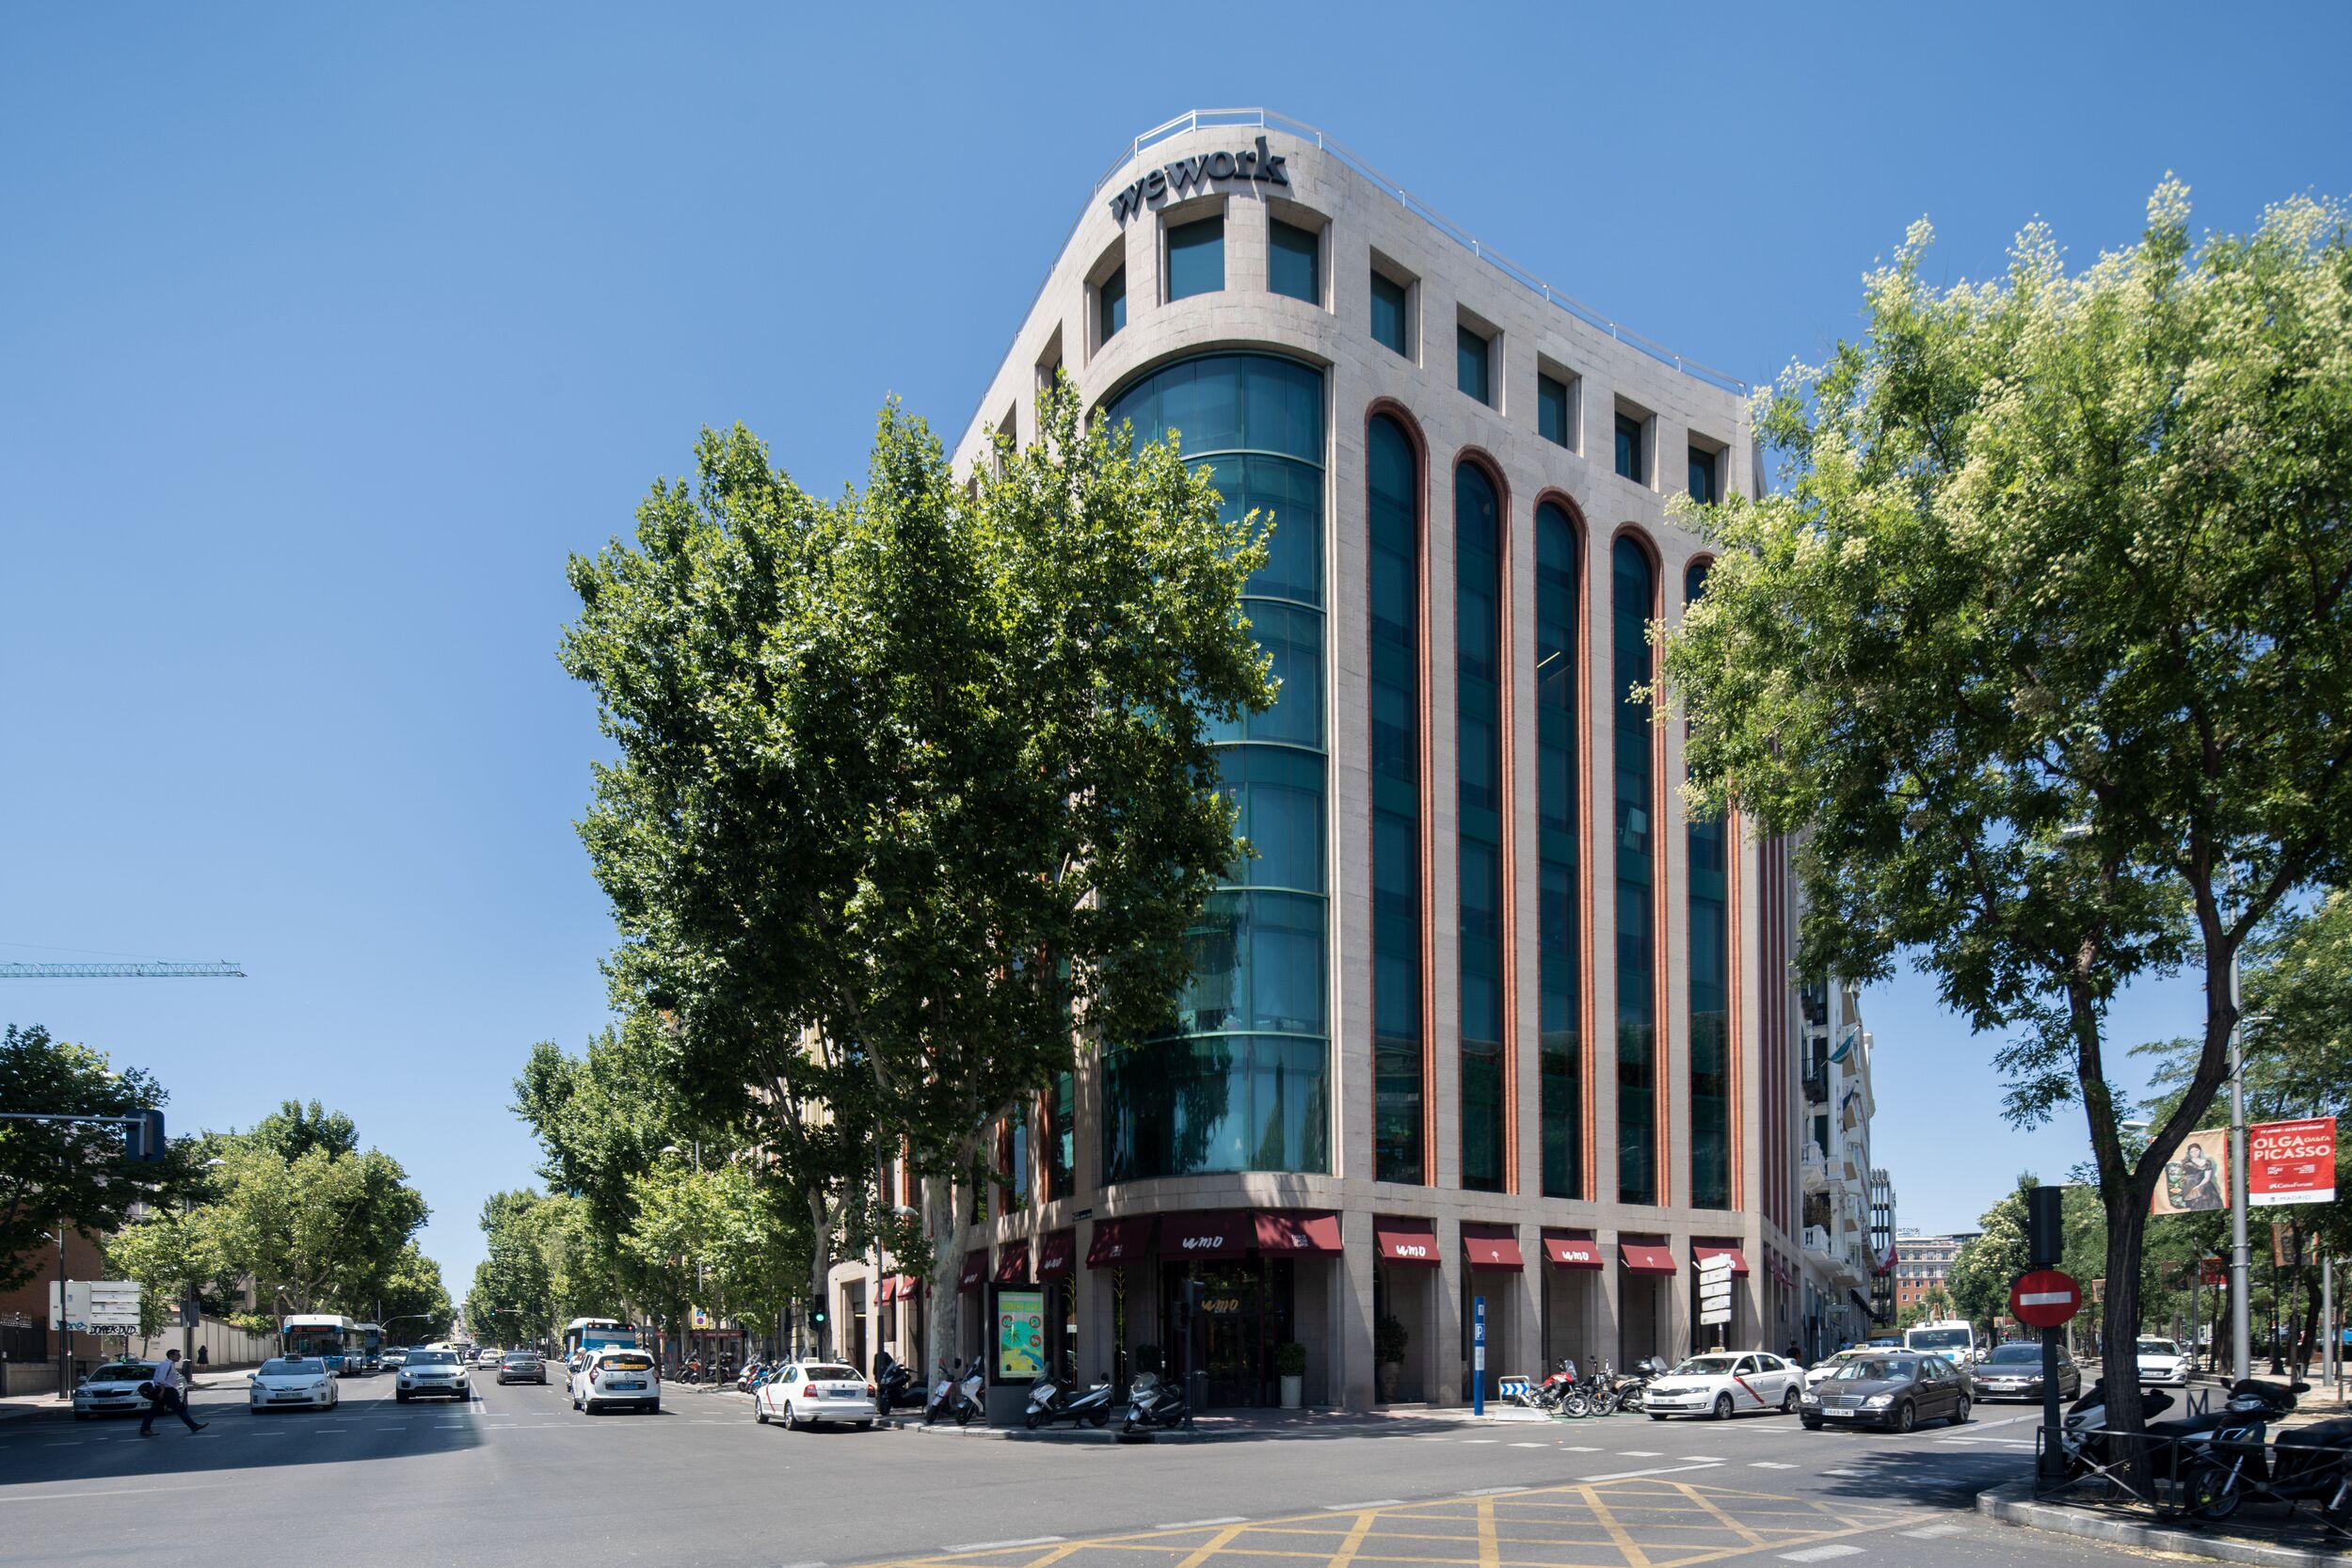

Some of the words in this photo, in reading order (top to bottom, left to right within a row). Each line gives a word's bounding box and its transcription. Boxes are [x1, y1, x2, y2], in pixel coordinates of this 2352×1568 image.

[1108, 135, 1288, 221] wework
[2253, 1136, 2305, 1149] OLGA
[2253, 1144, 2331, 1161] PICASSO
[1477, 1325, 1483, 1338] P
